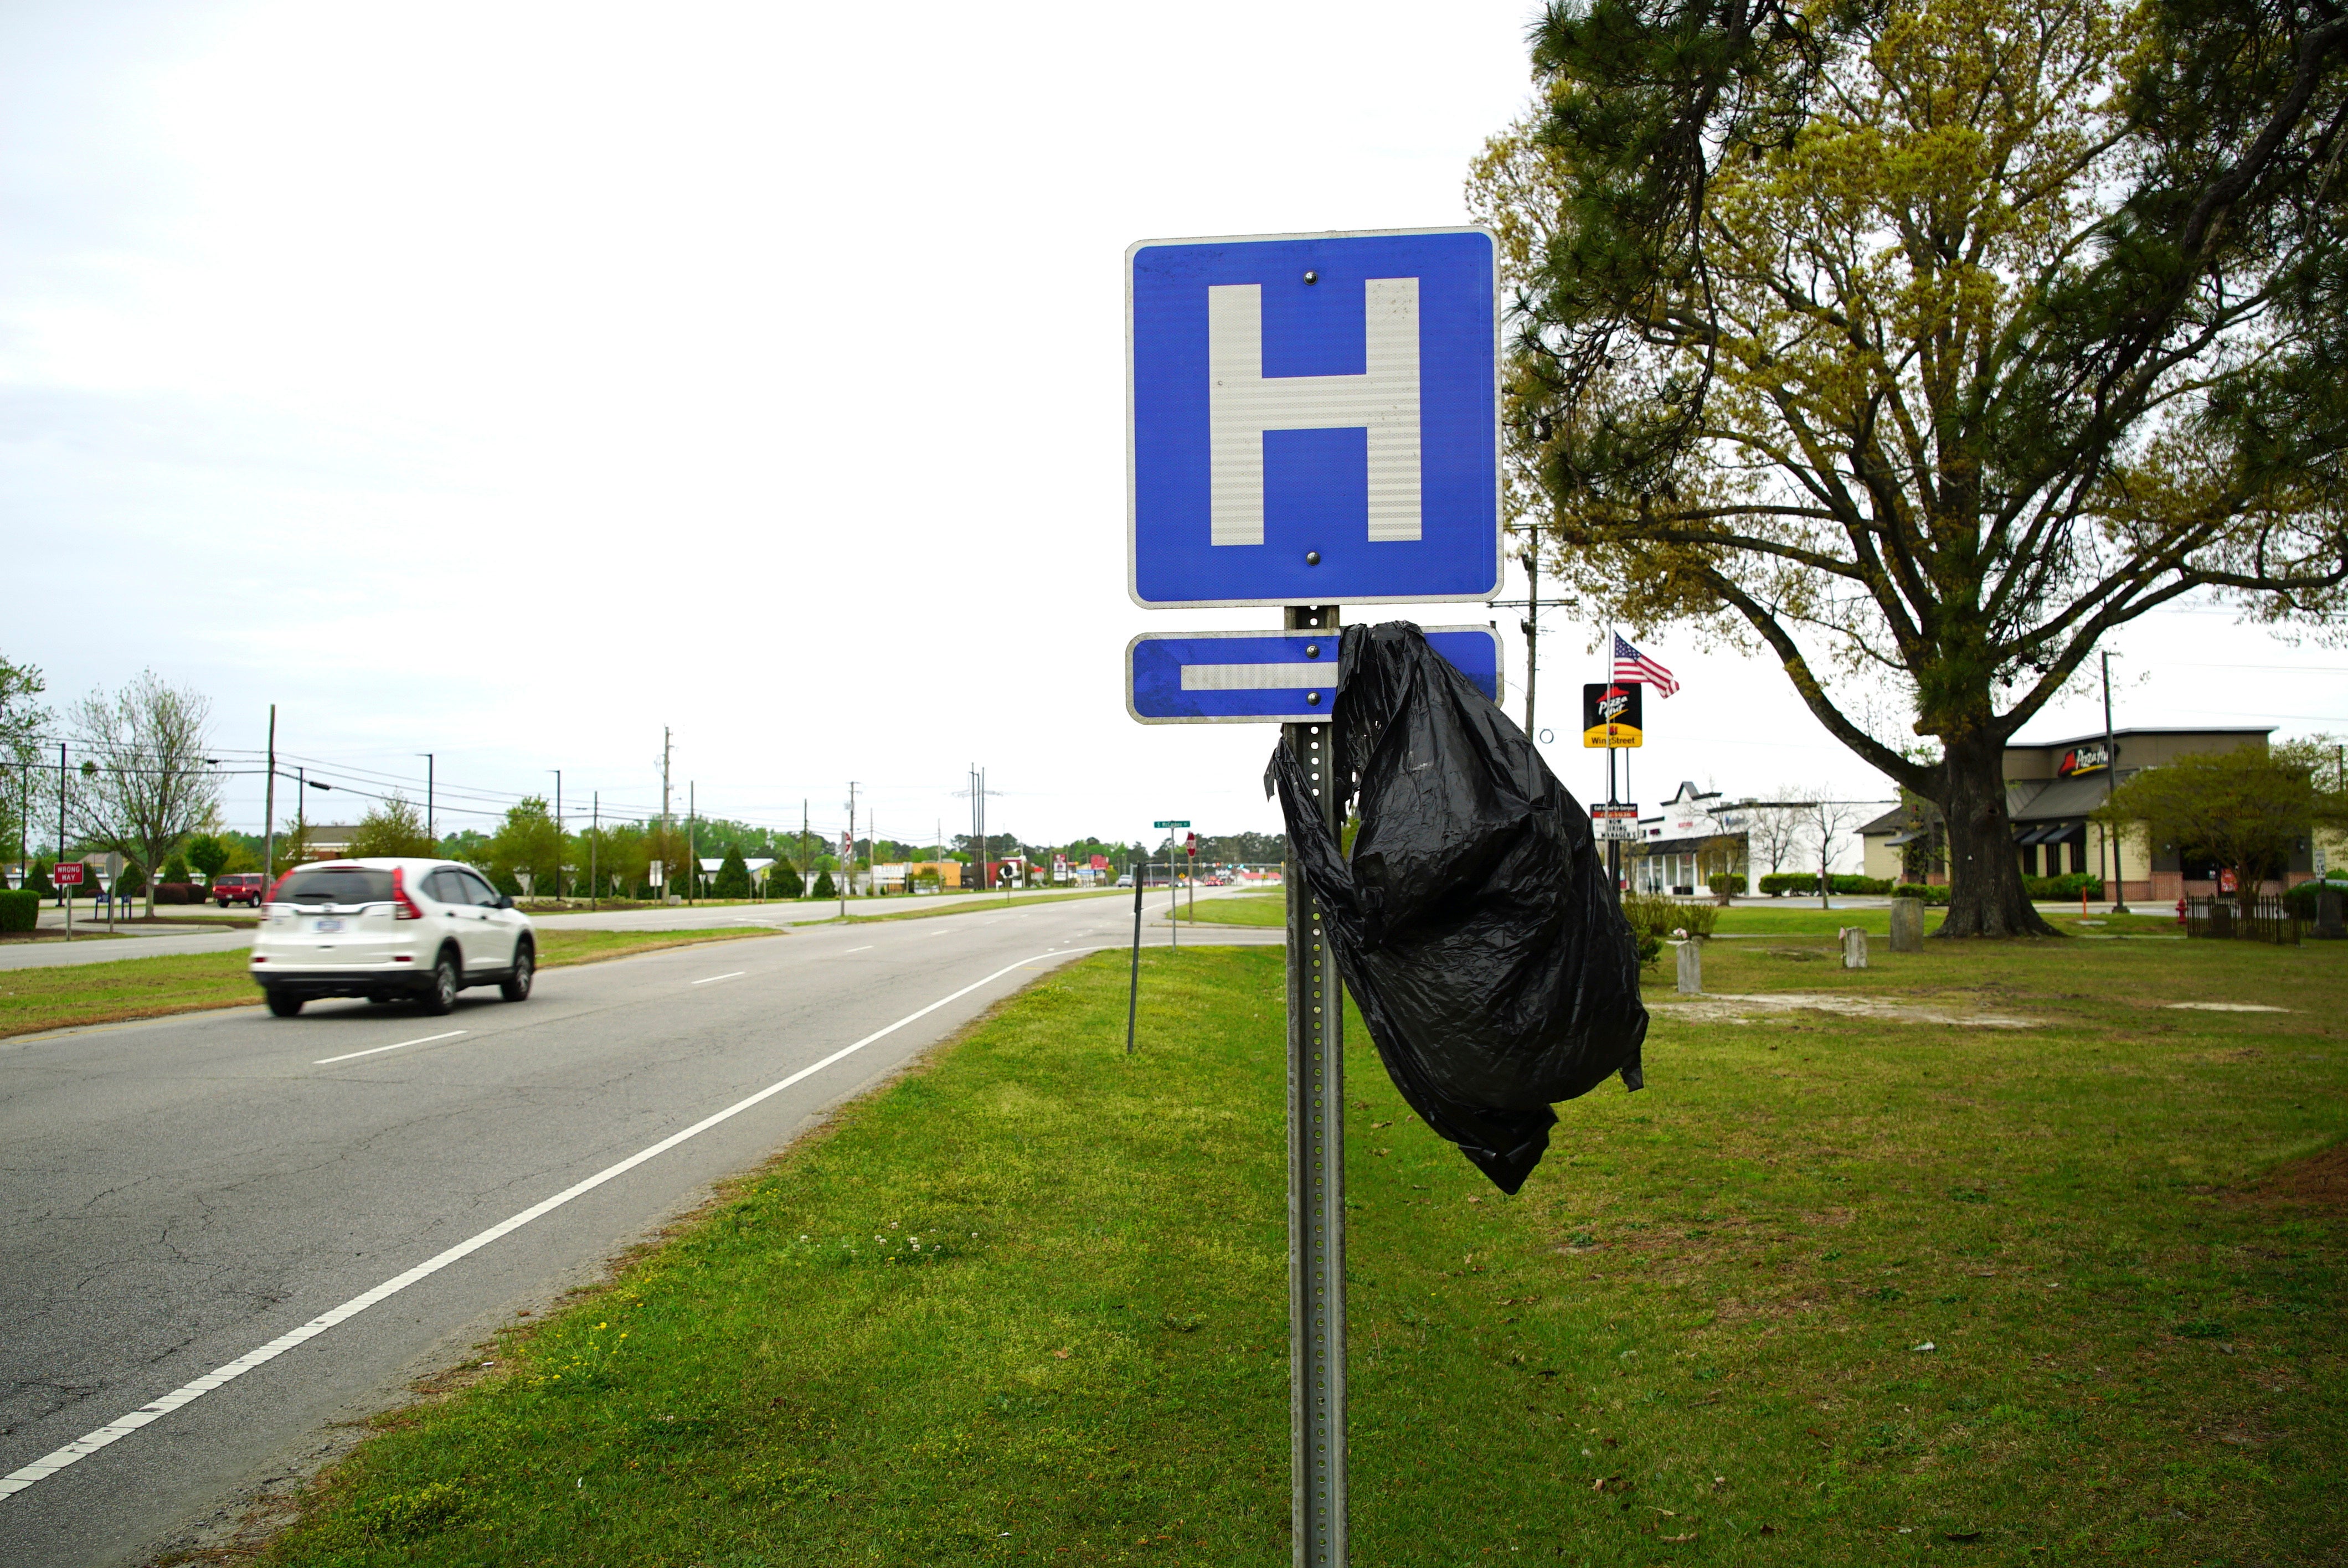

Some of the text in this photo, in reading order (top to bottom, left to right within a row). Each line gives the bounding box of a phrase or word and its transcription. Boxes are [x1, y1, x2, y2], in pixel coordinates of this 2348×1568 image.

[1208, 277, 1423, 546] H
[1598, 696, 1628, 716] Pzza
[2316, 864, 2325, 875] 35
